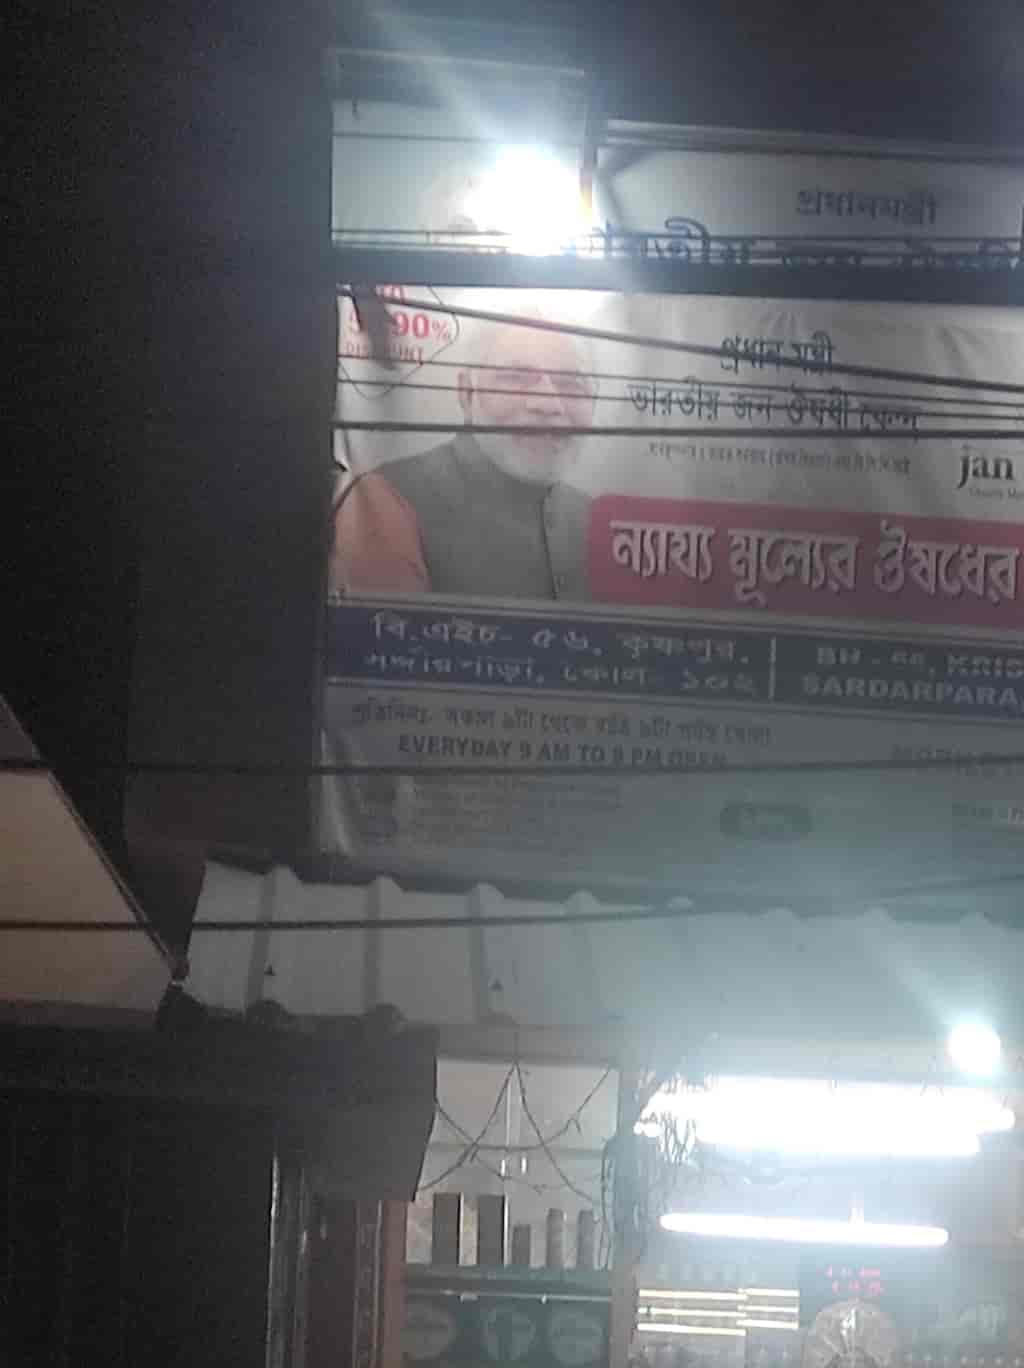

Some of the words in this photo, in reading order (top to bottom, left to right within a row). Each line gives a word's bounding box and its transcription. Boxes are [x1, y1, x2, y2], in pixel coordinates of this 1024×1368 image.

[957, 444, 1014, 488] jan
[609, 519, 716, 582] ন্যায্য
[729, 524, 858, 606] মূল্যের
[874, 519, 1020, 606] ঔষধের
